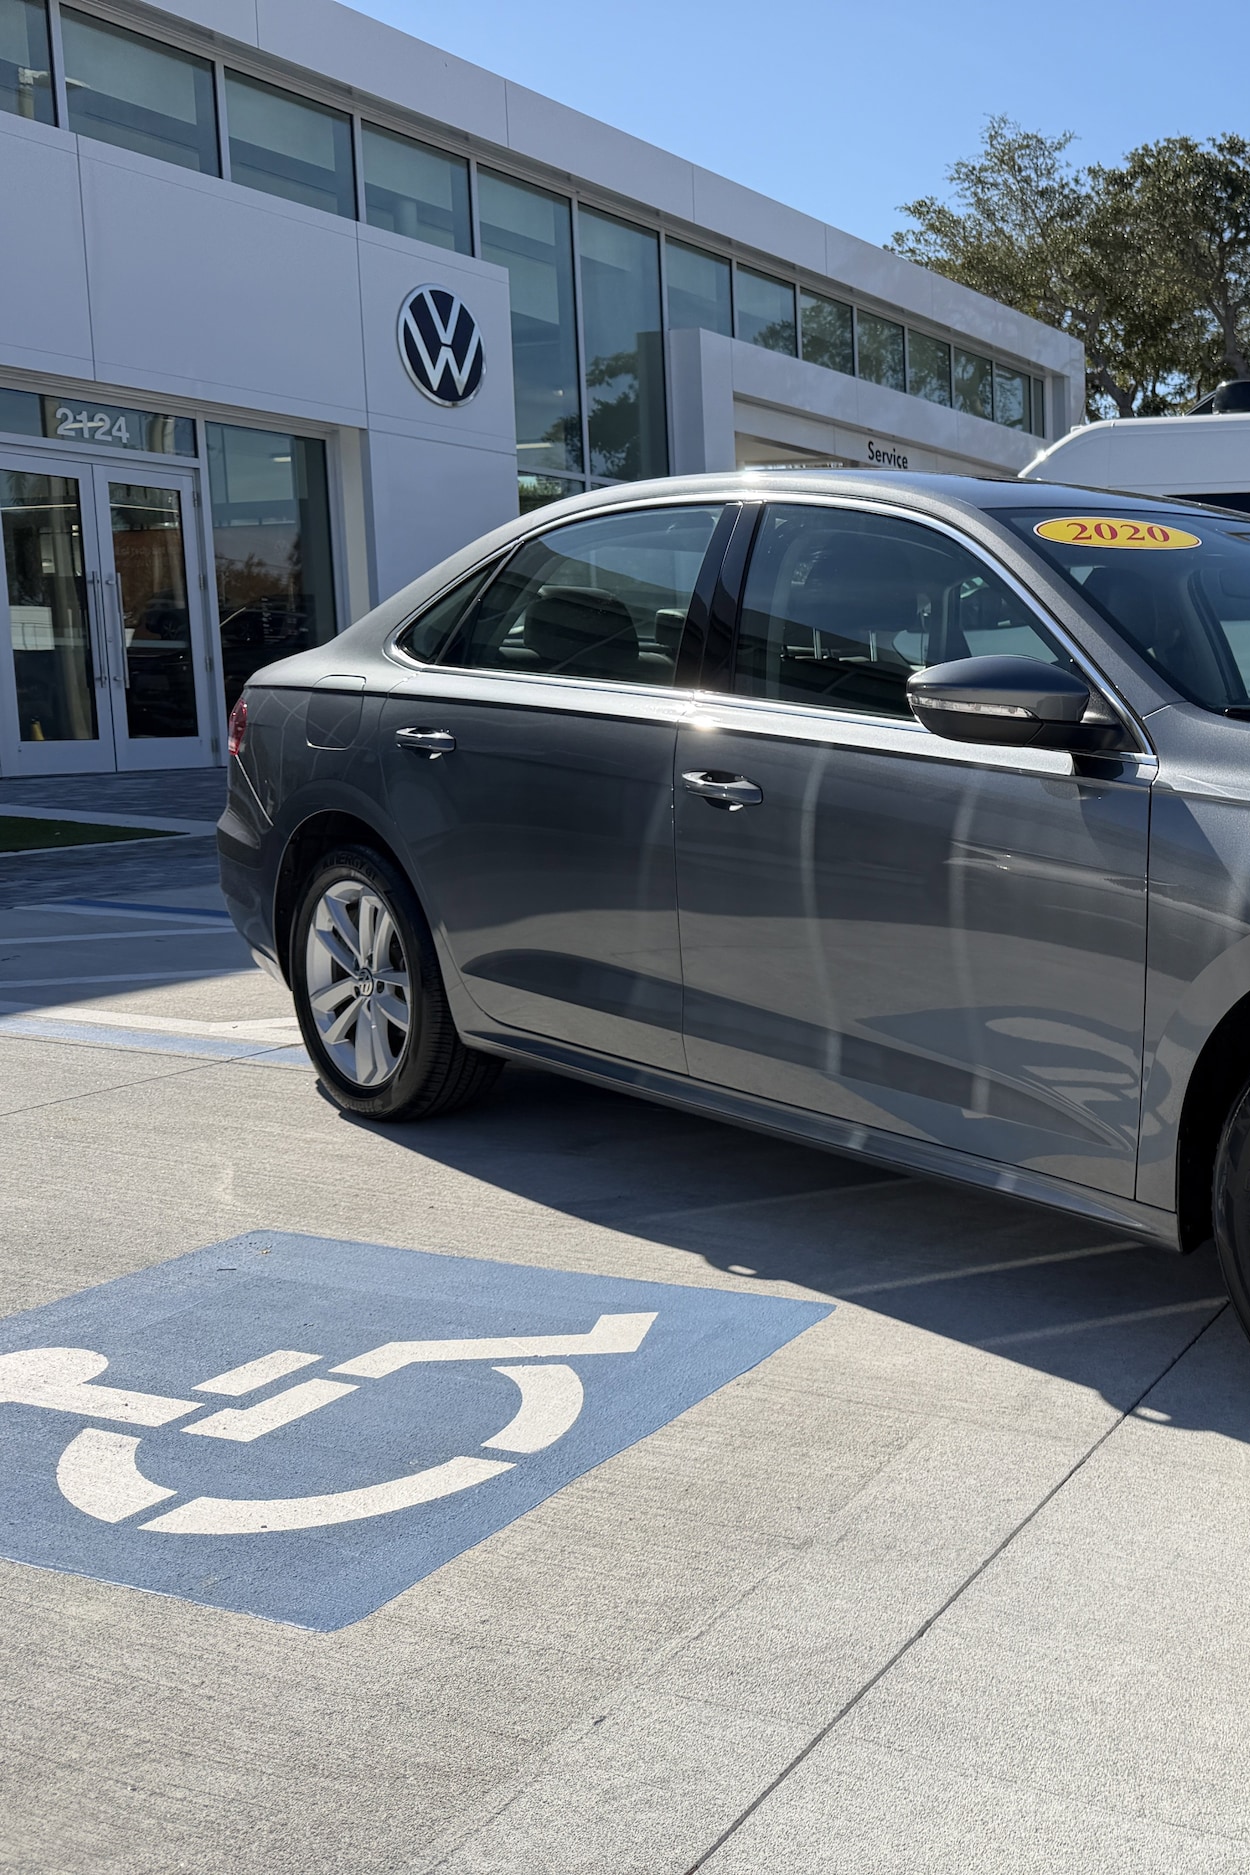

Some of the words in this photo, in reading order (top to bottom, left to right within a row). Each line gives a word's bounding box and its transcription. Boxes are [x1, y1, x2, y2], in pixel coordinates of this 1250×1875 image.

[55, 407, 130, 443] 2124
[868, 440, 908, 470] Service
[1066, 522, 1170, 543] 2020
